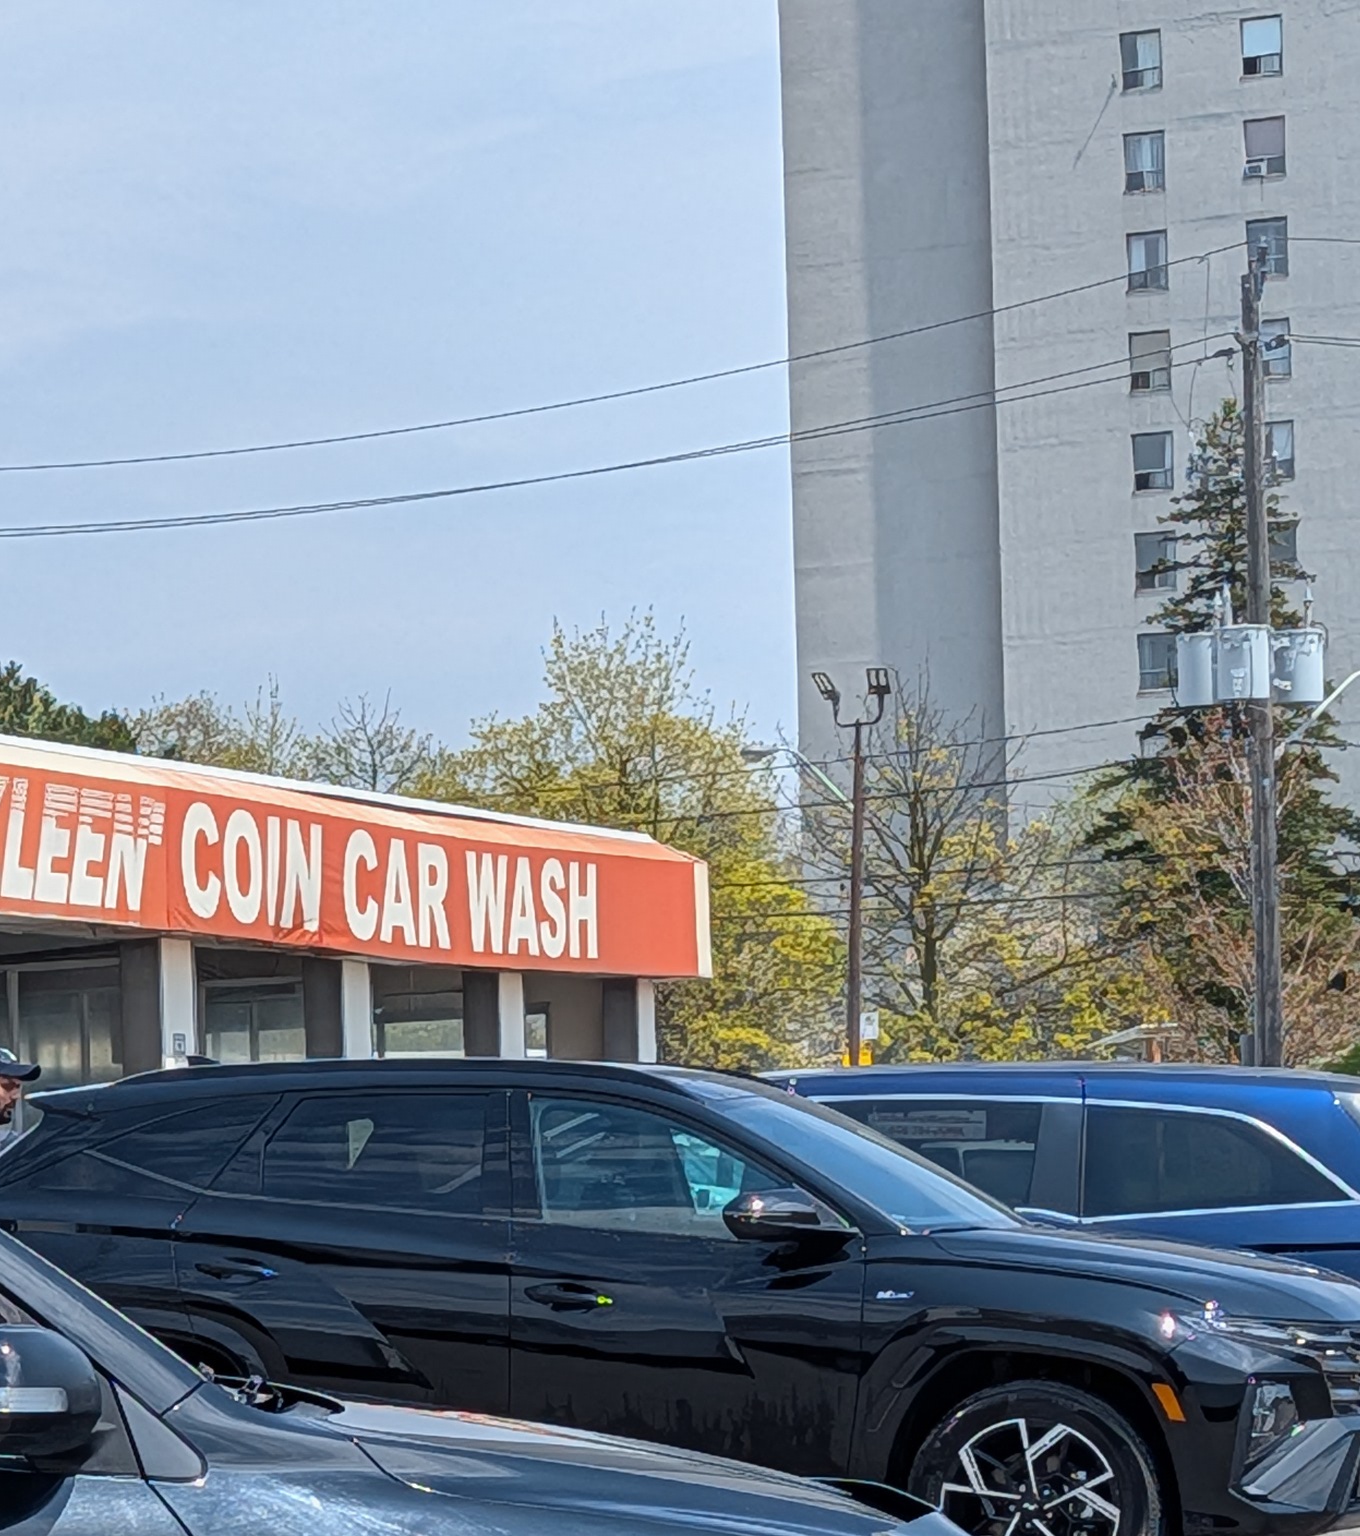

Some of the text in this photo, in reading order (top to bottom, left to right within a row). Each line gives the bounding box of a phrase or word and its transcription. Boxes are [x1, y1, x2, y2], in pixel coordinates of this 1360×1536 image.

[180, 801, 323, 933] COIN
[343, 829, 452, 951] CAR
[465, 850, 600, 960] WASH
